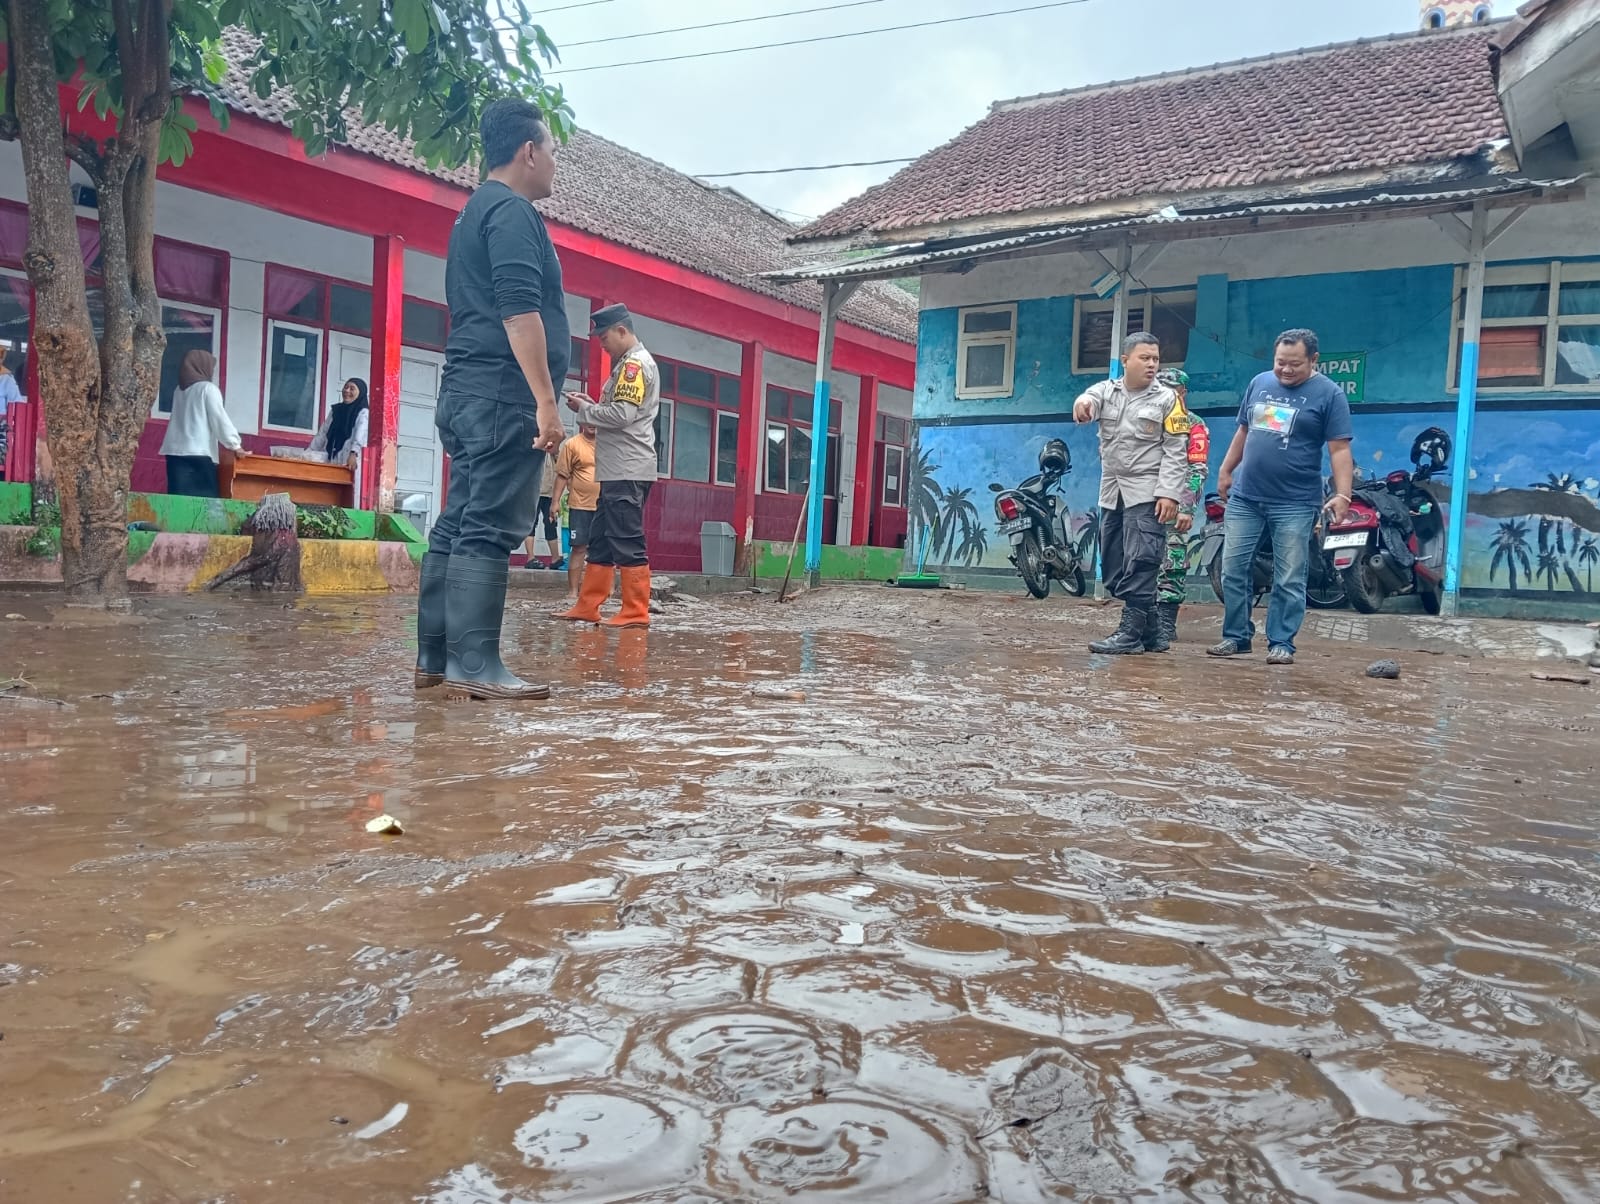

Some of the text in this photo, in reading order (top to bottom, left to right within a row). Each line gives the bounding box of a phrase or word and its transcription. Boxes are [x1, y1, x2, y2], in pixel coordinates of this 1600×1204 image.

[1315, 360, 1360, 374] MPAT
[617, 384, 640, 394] KANIT
[1337, 381, 1357, 394] IR
